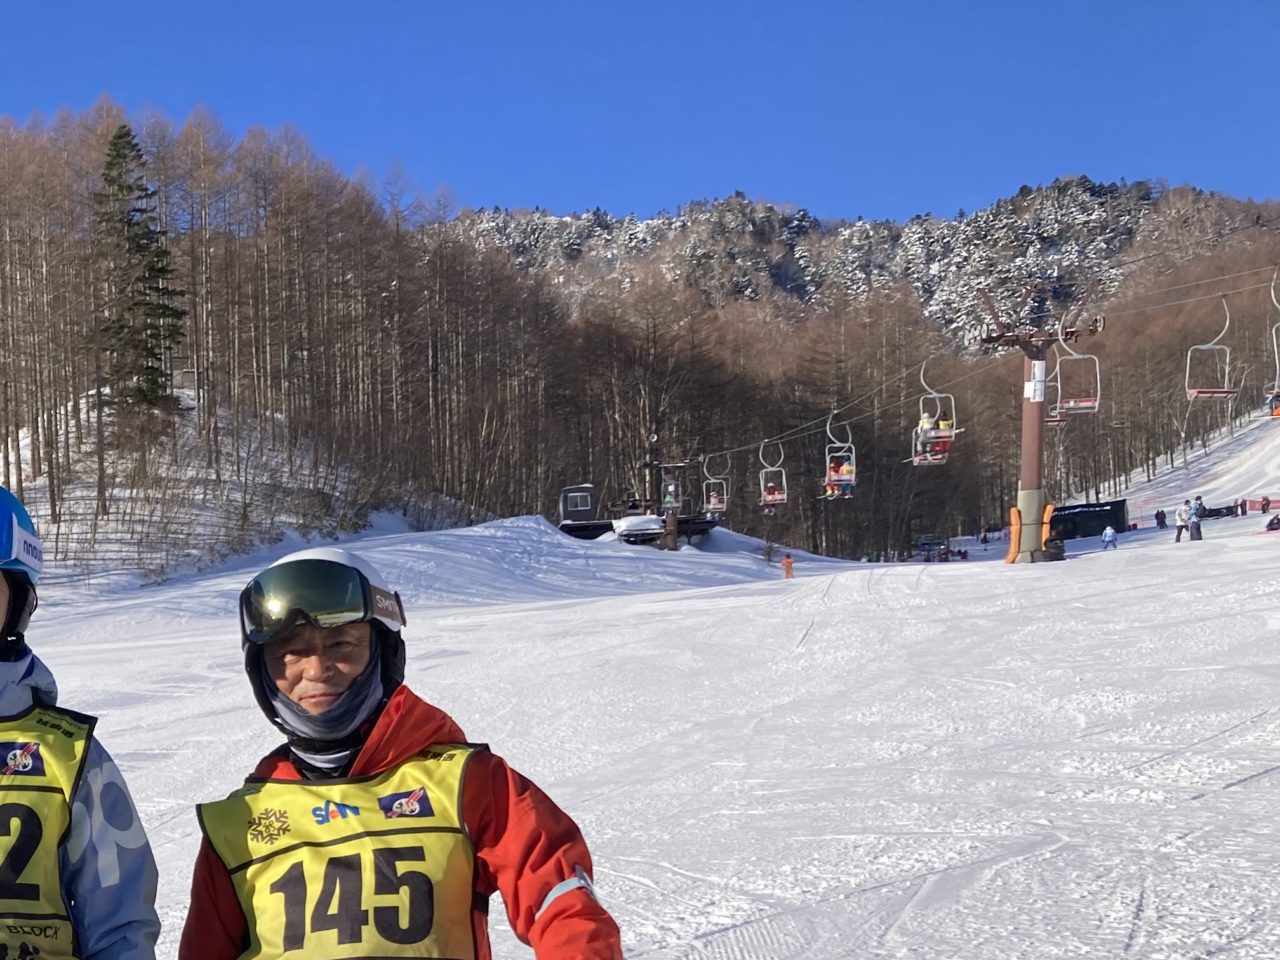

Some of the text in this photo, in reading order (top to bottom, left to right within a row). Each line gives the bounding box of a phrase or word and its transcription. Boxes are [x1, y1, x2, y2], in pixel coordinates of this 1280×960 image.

[312, 800, 360, 825] SAN
[270, 846, 434, 952] 145
[7, 924, 62, 940] BLOCK
